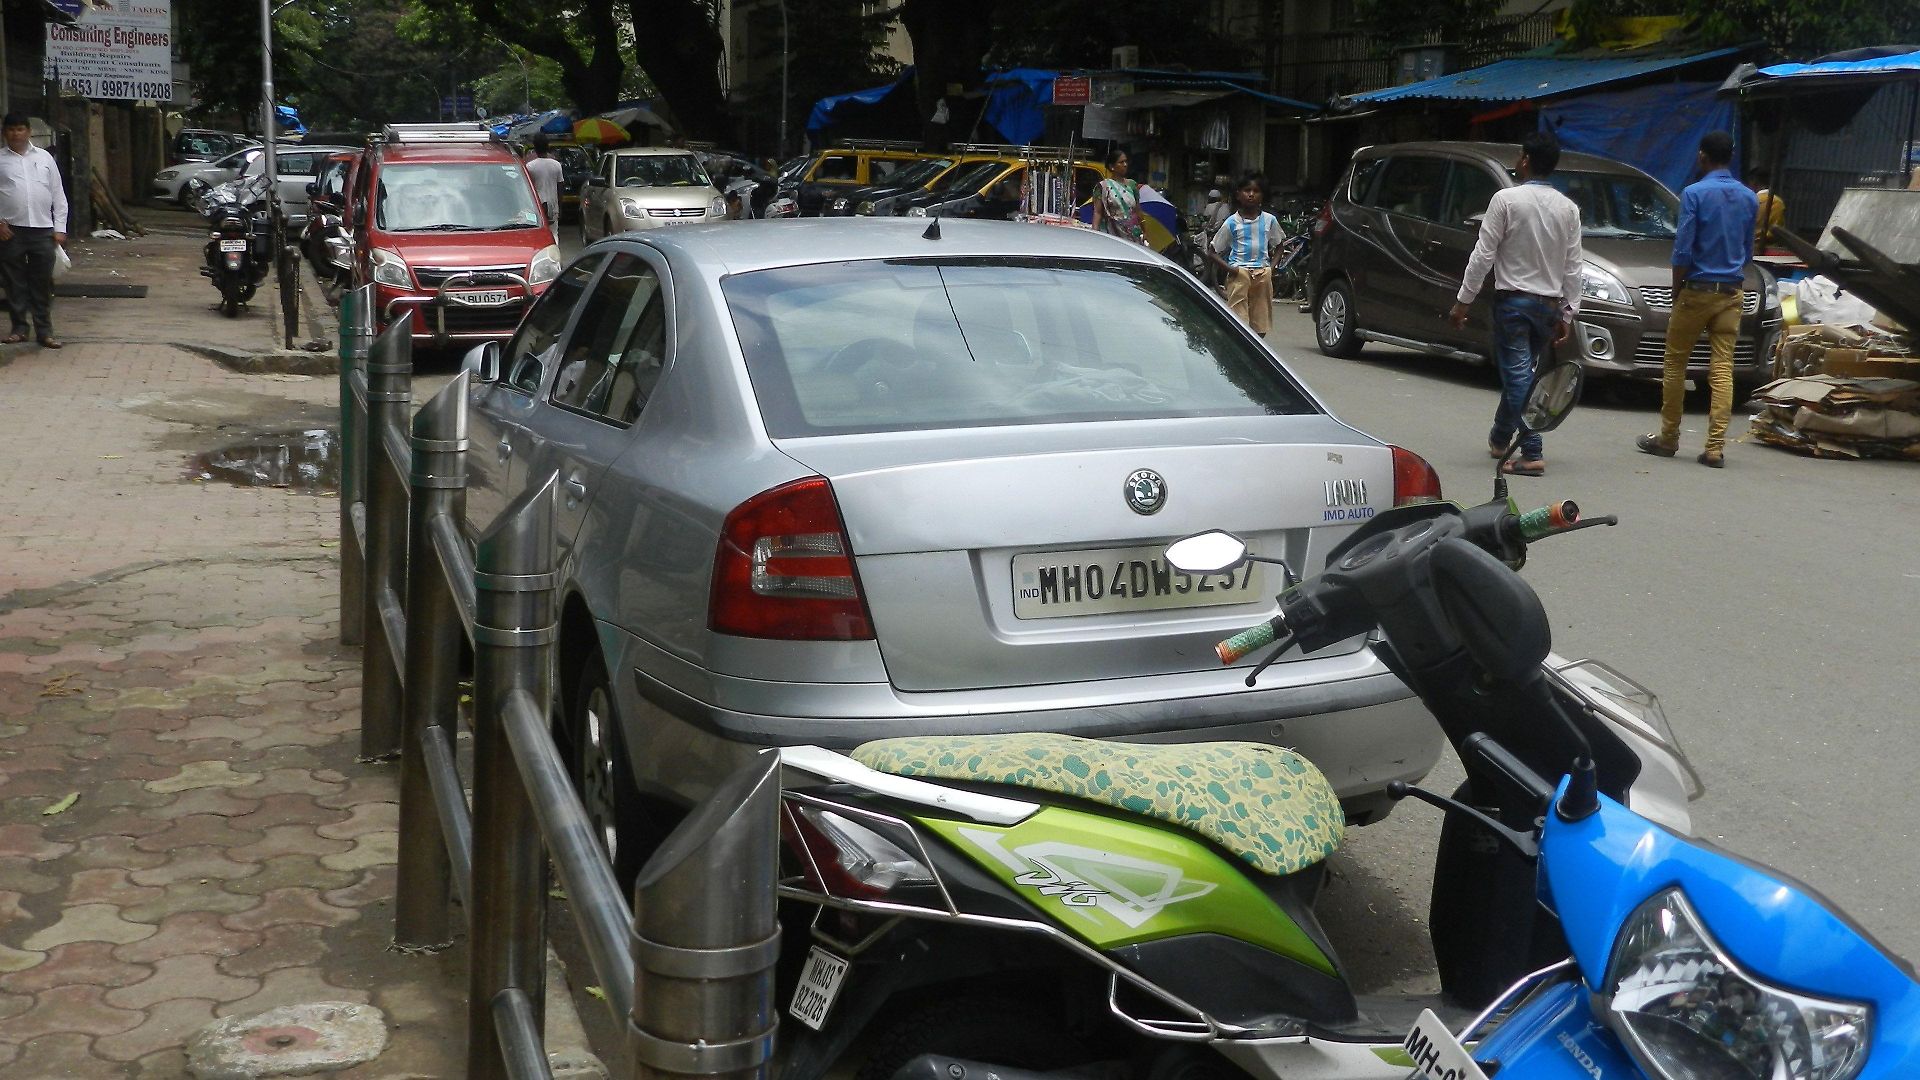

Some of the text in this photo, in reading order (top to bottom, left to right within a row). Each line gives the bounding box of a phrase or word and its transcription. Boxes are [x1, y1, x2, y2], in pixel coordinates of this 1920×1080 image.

[51, 23, 169, 48] Consulting Engineers
[61, 51, 97, 59] Building
[111, 60, 161, 68] Consultants
[102, 80, 171, 100] 9987119208
[1323, 507, 1375, 521] JMD AUTO
[1019, 587, 1039, 599] IND
[1556, 1031, 1603, 1080] HONDA
